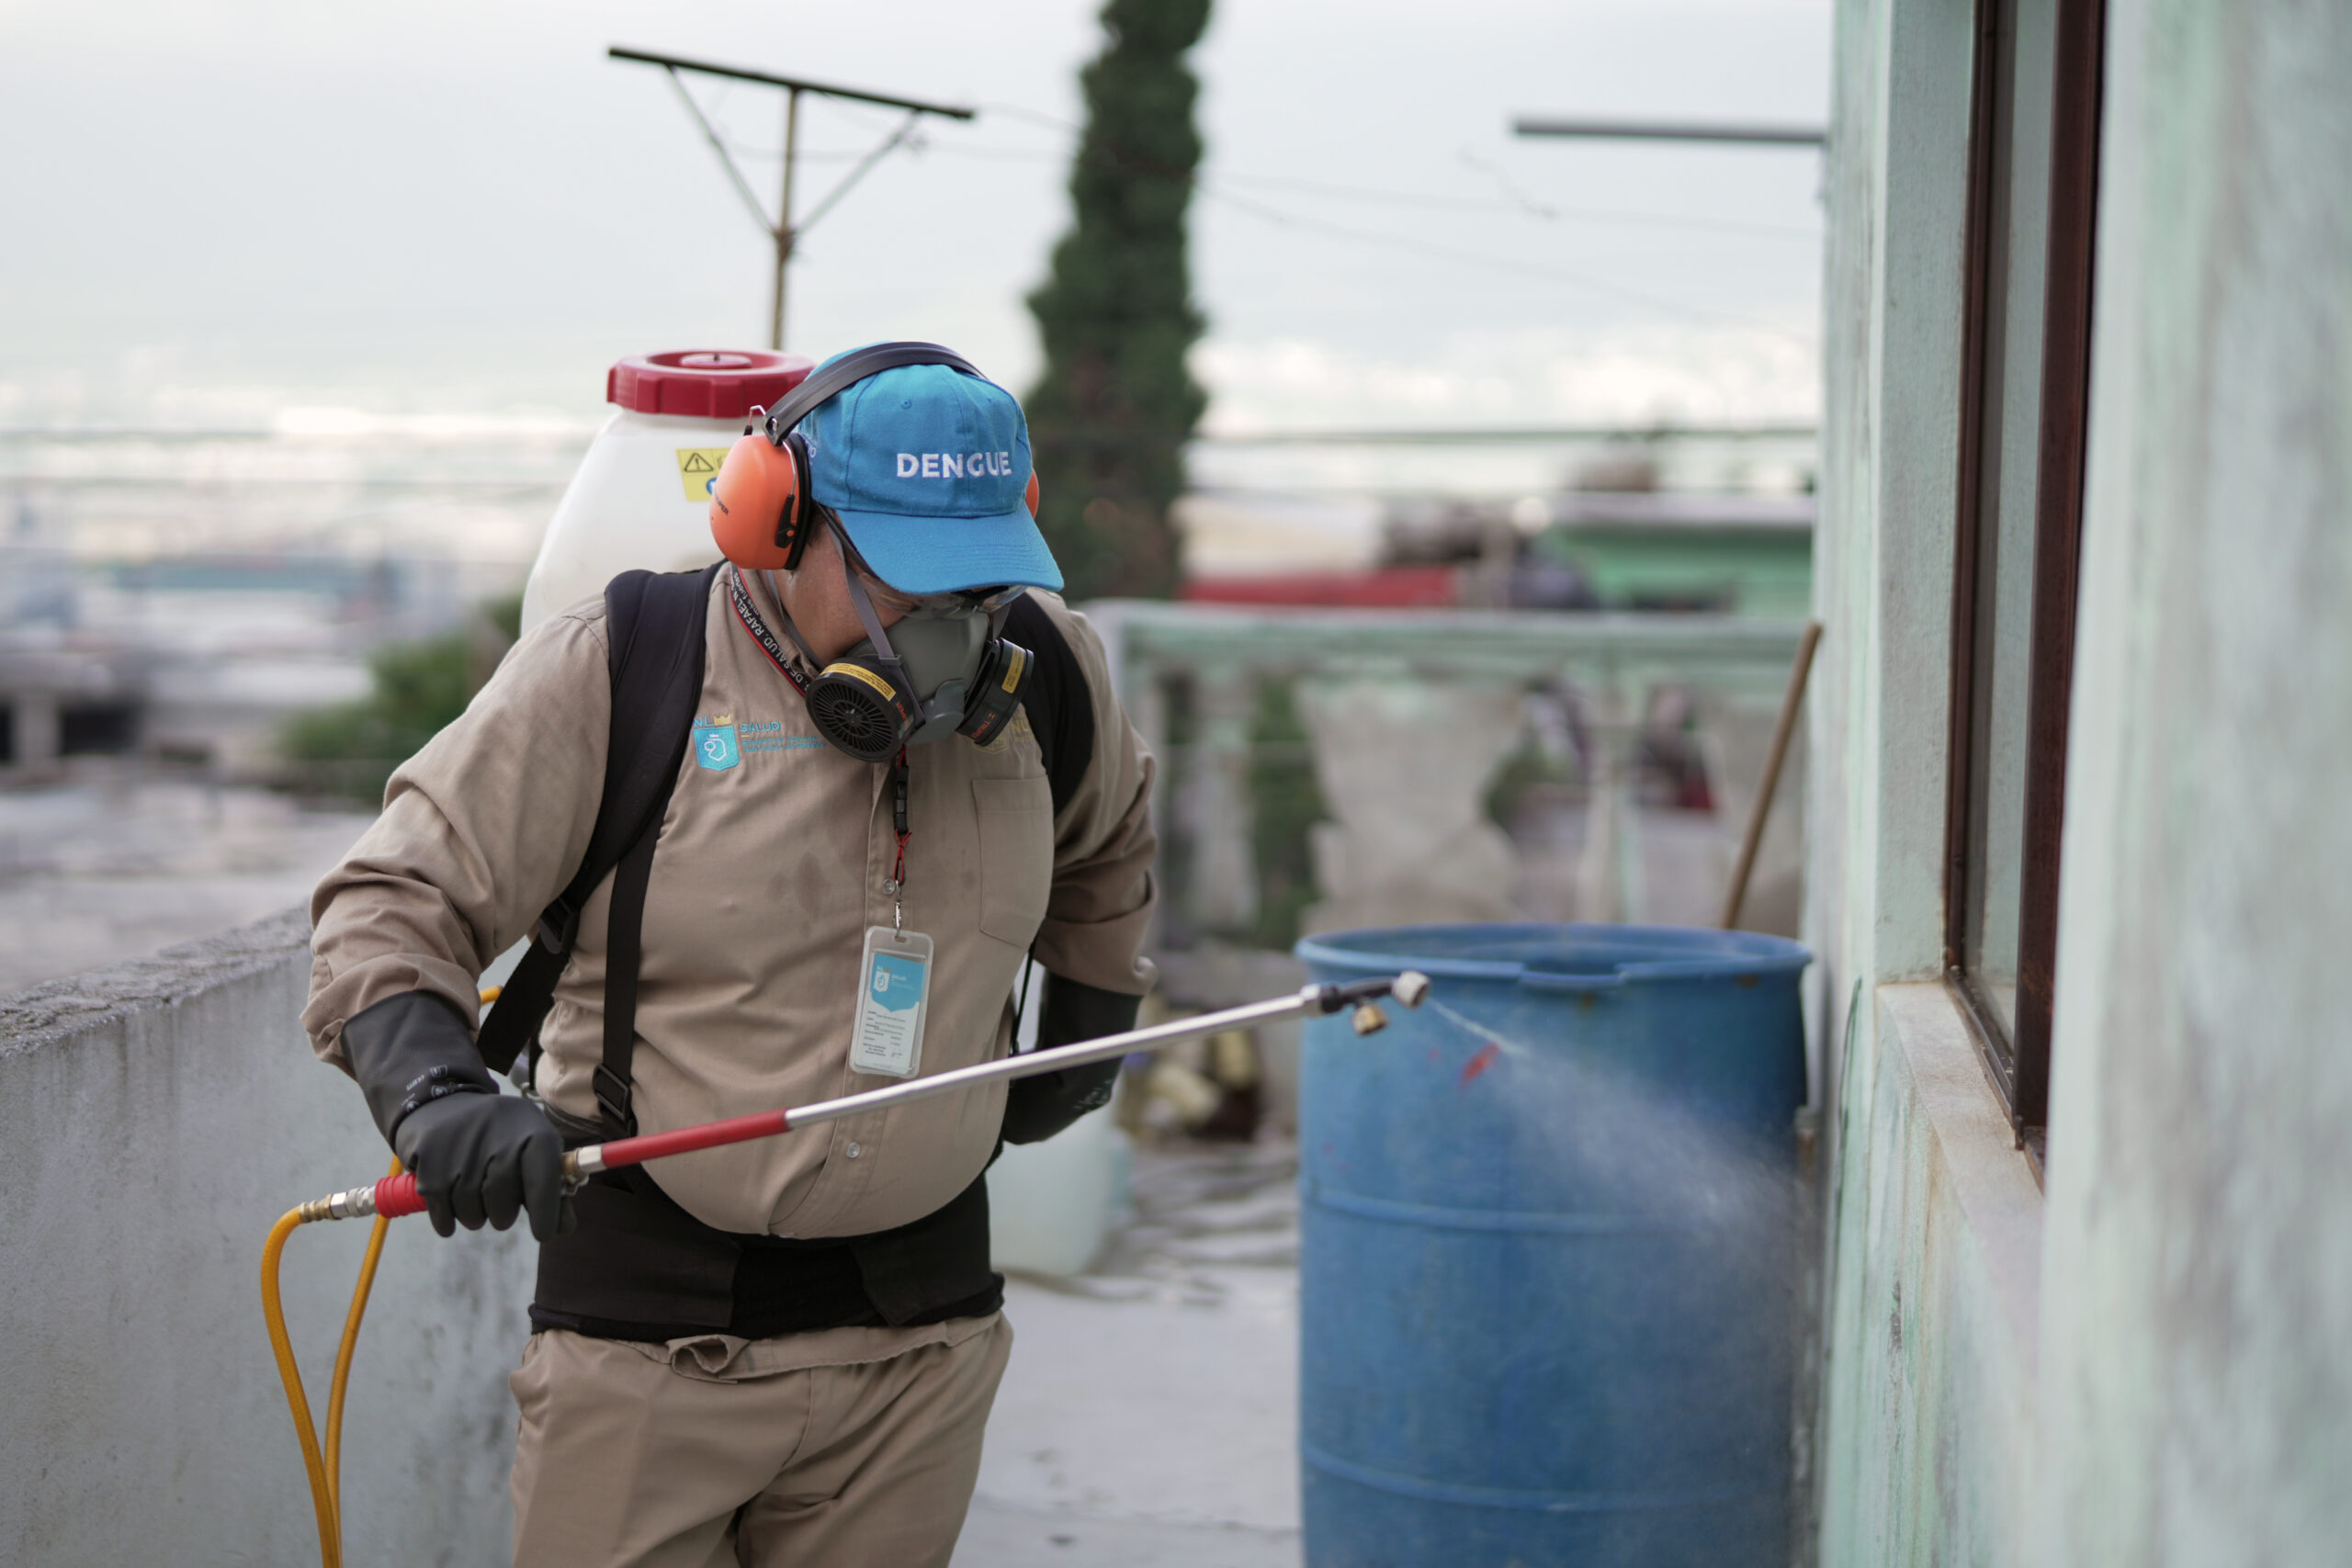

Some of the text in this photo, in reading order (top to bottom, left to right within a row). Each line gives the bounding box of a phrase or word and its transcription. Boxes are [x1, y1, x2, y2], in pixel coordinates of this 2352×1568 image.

[897, 451, 1012, 479] DENGUE
[737, 598, 764, 636] RAFAEL
[693, 716, 714, 728] NL
[740, 721, 781, 733] SALUD
